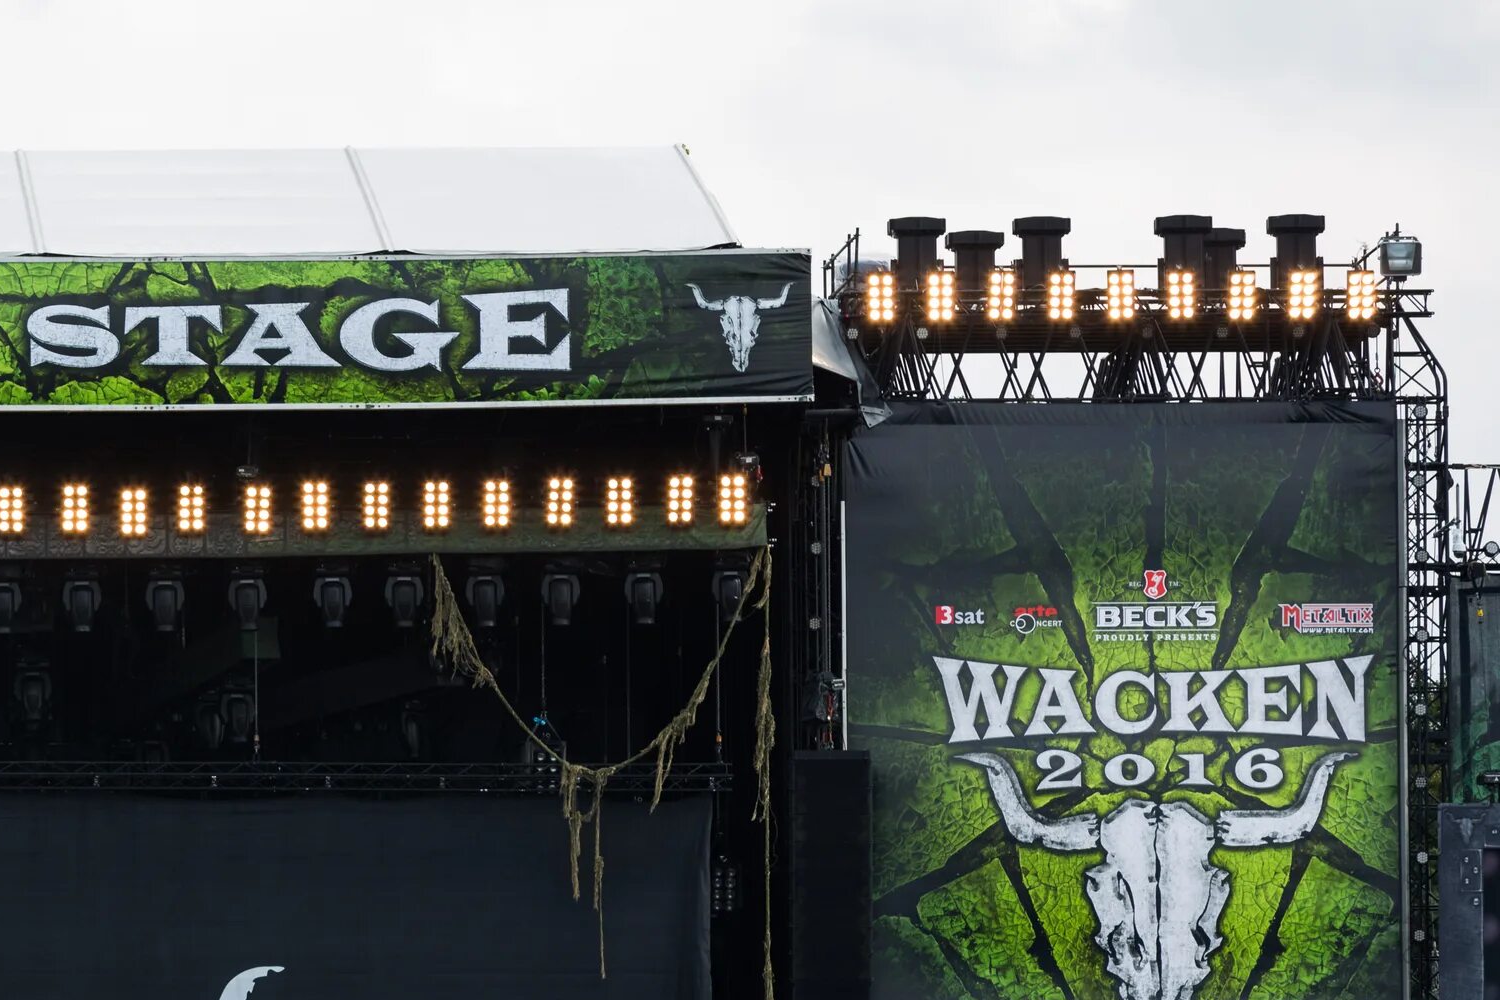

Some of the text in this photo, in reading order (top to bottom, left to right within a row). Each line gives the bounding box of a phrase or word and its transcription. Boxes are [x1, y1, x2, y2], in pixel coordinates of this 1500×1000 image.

[26, 287, 571, 374] STAGE
[940, 605, 985, 625] 3sat
[1014, 605, 1058, 617] arte
[1096, 602, 1217, 628] BECK'S
[1278, 603, 1373, 633] METALTIX
[1095, 633, 1217, 641] PROUDLY PRESENTS
[933, 654, 1374, 743] WACKEN
[1036, 748, 1284, 791] 2016
